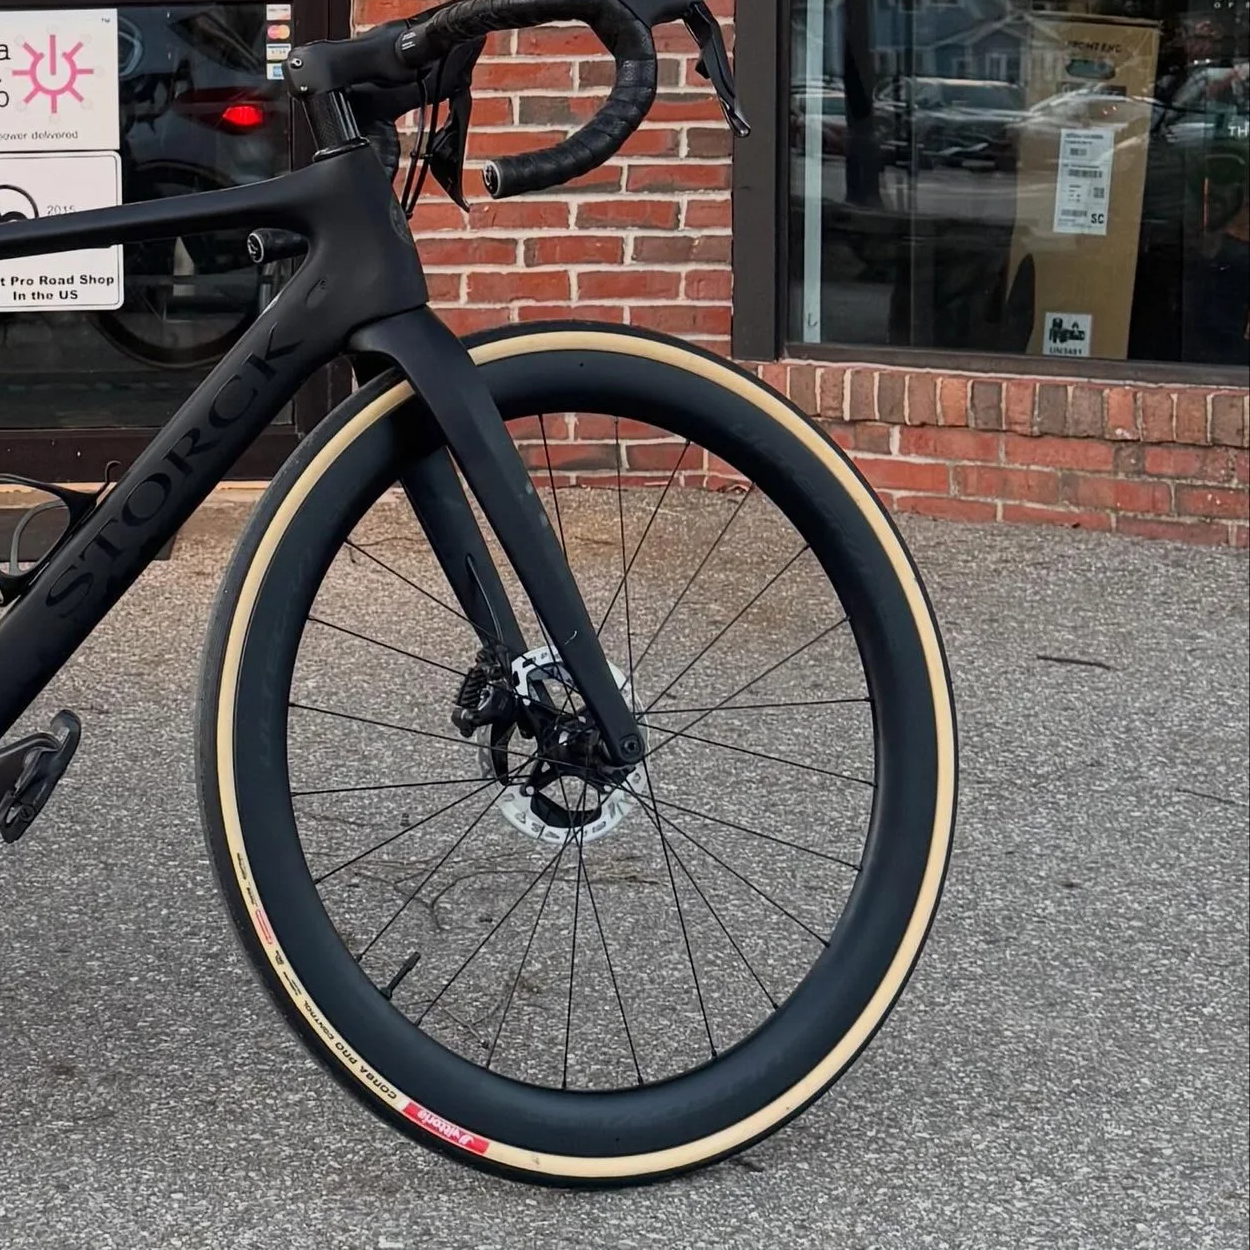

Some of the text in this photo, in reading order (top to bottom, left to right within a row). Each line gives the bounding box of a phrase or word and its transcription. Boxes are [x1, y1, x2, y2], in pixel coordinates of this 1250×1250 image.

[31, 130, 79, 140] delivered
[1091, 213, 1105, 224] SC
[10, 275, 35, 286] Pro
[39, 275, 75, 285] Road
[79, 273, 115, 286] Shop
[13, 289, 79, 301] In the US
[45, 322, 304, 617] STORCK
